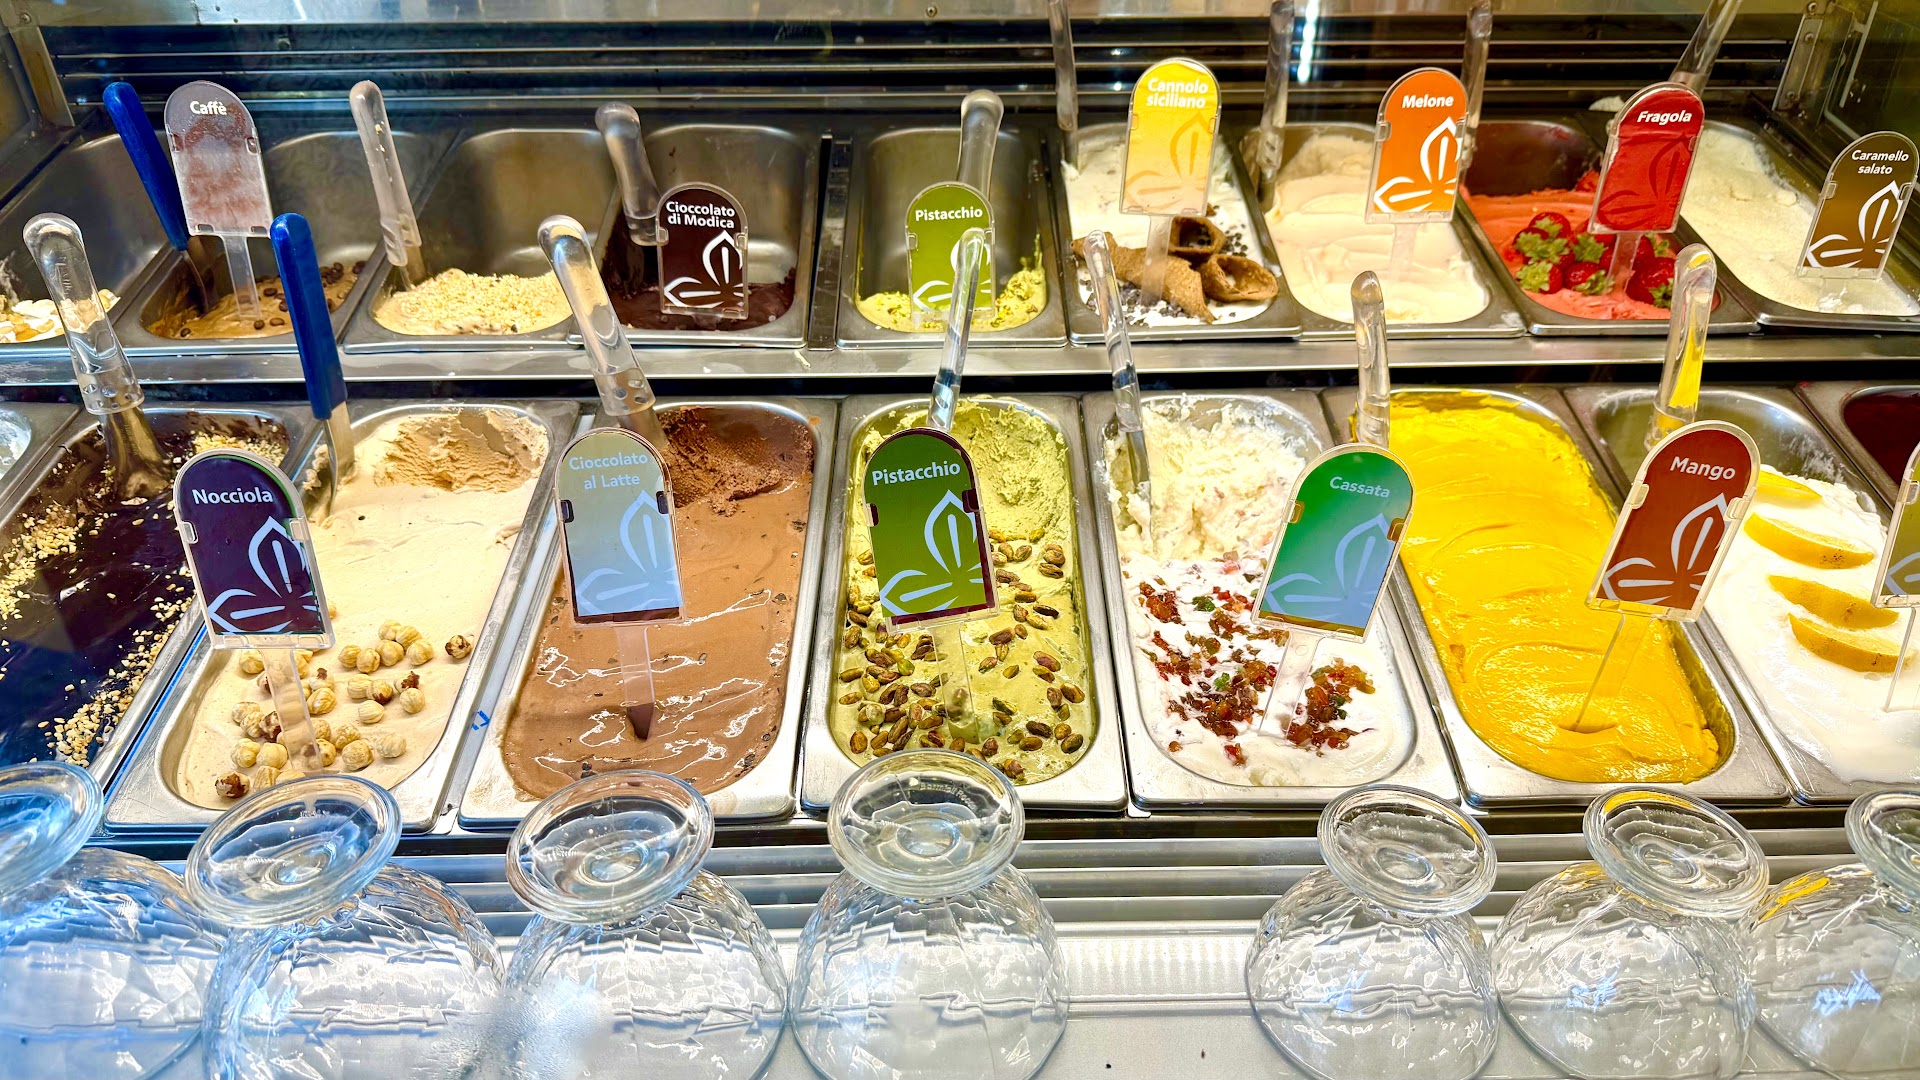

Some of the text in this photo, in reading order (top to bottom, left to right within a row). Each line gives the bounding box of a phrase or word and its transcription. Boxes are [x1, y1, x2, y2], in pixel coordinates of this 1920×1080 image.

[1147, 78, 1209, 94] Cannolo
[190, 100, 227, 116] Caffè
[1147, 92, 1206, 109] siciliano
[1402, 94, 1454, 109] Melone
[1637, 109, 1693, 126] Fragola
[1852, 149, 1910, 163] Caramello
[1858, 163, 1893, 175] salato
[666, 202, 735, 217] Cioccolato
[915, 206, 983, 222] Pistacchio
[668, 212, 735, 229] di Modica
[568, 452, 649, 471] Cioccolato
[1670, 456, 1737, 481] Mango
[872, 460, 961, 487] Pistacchio
[584, 474, 640, 490] al Latte
[1329, 475, 1390, 499] Cassata
[192, 487, 273, 504] Nocciola
